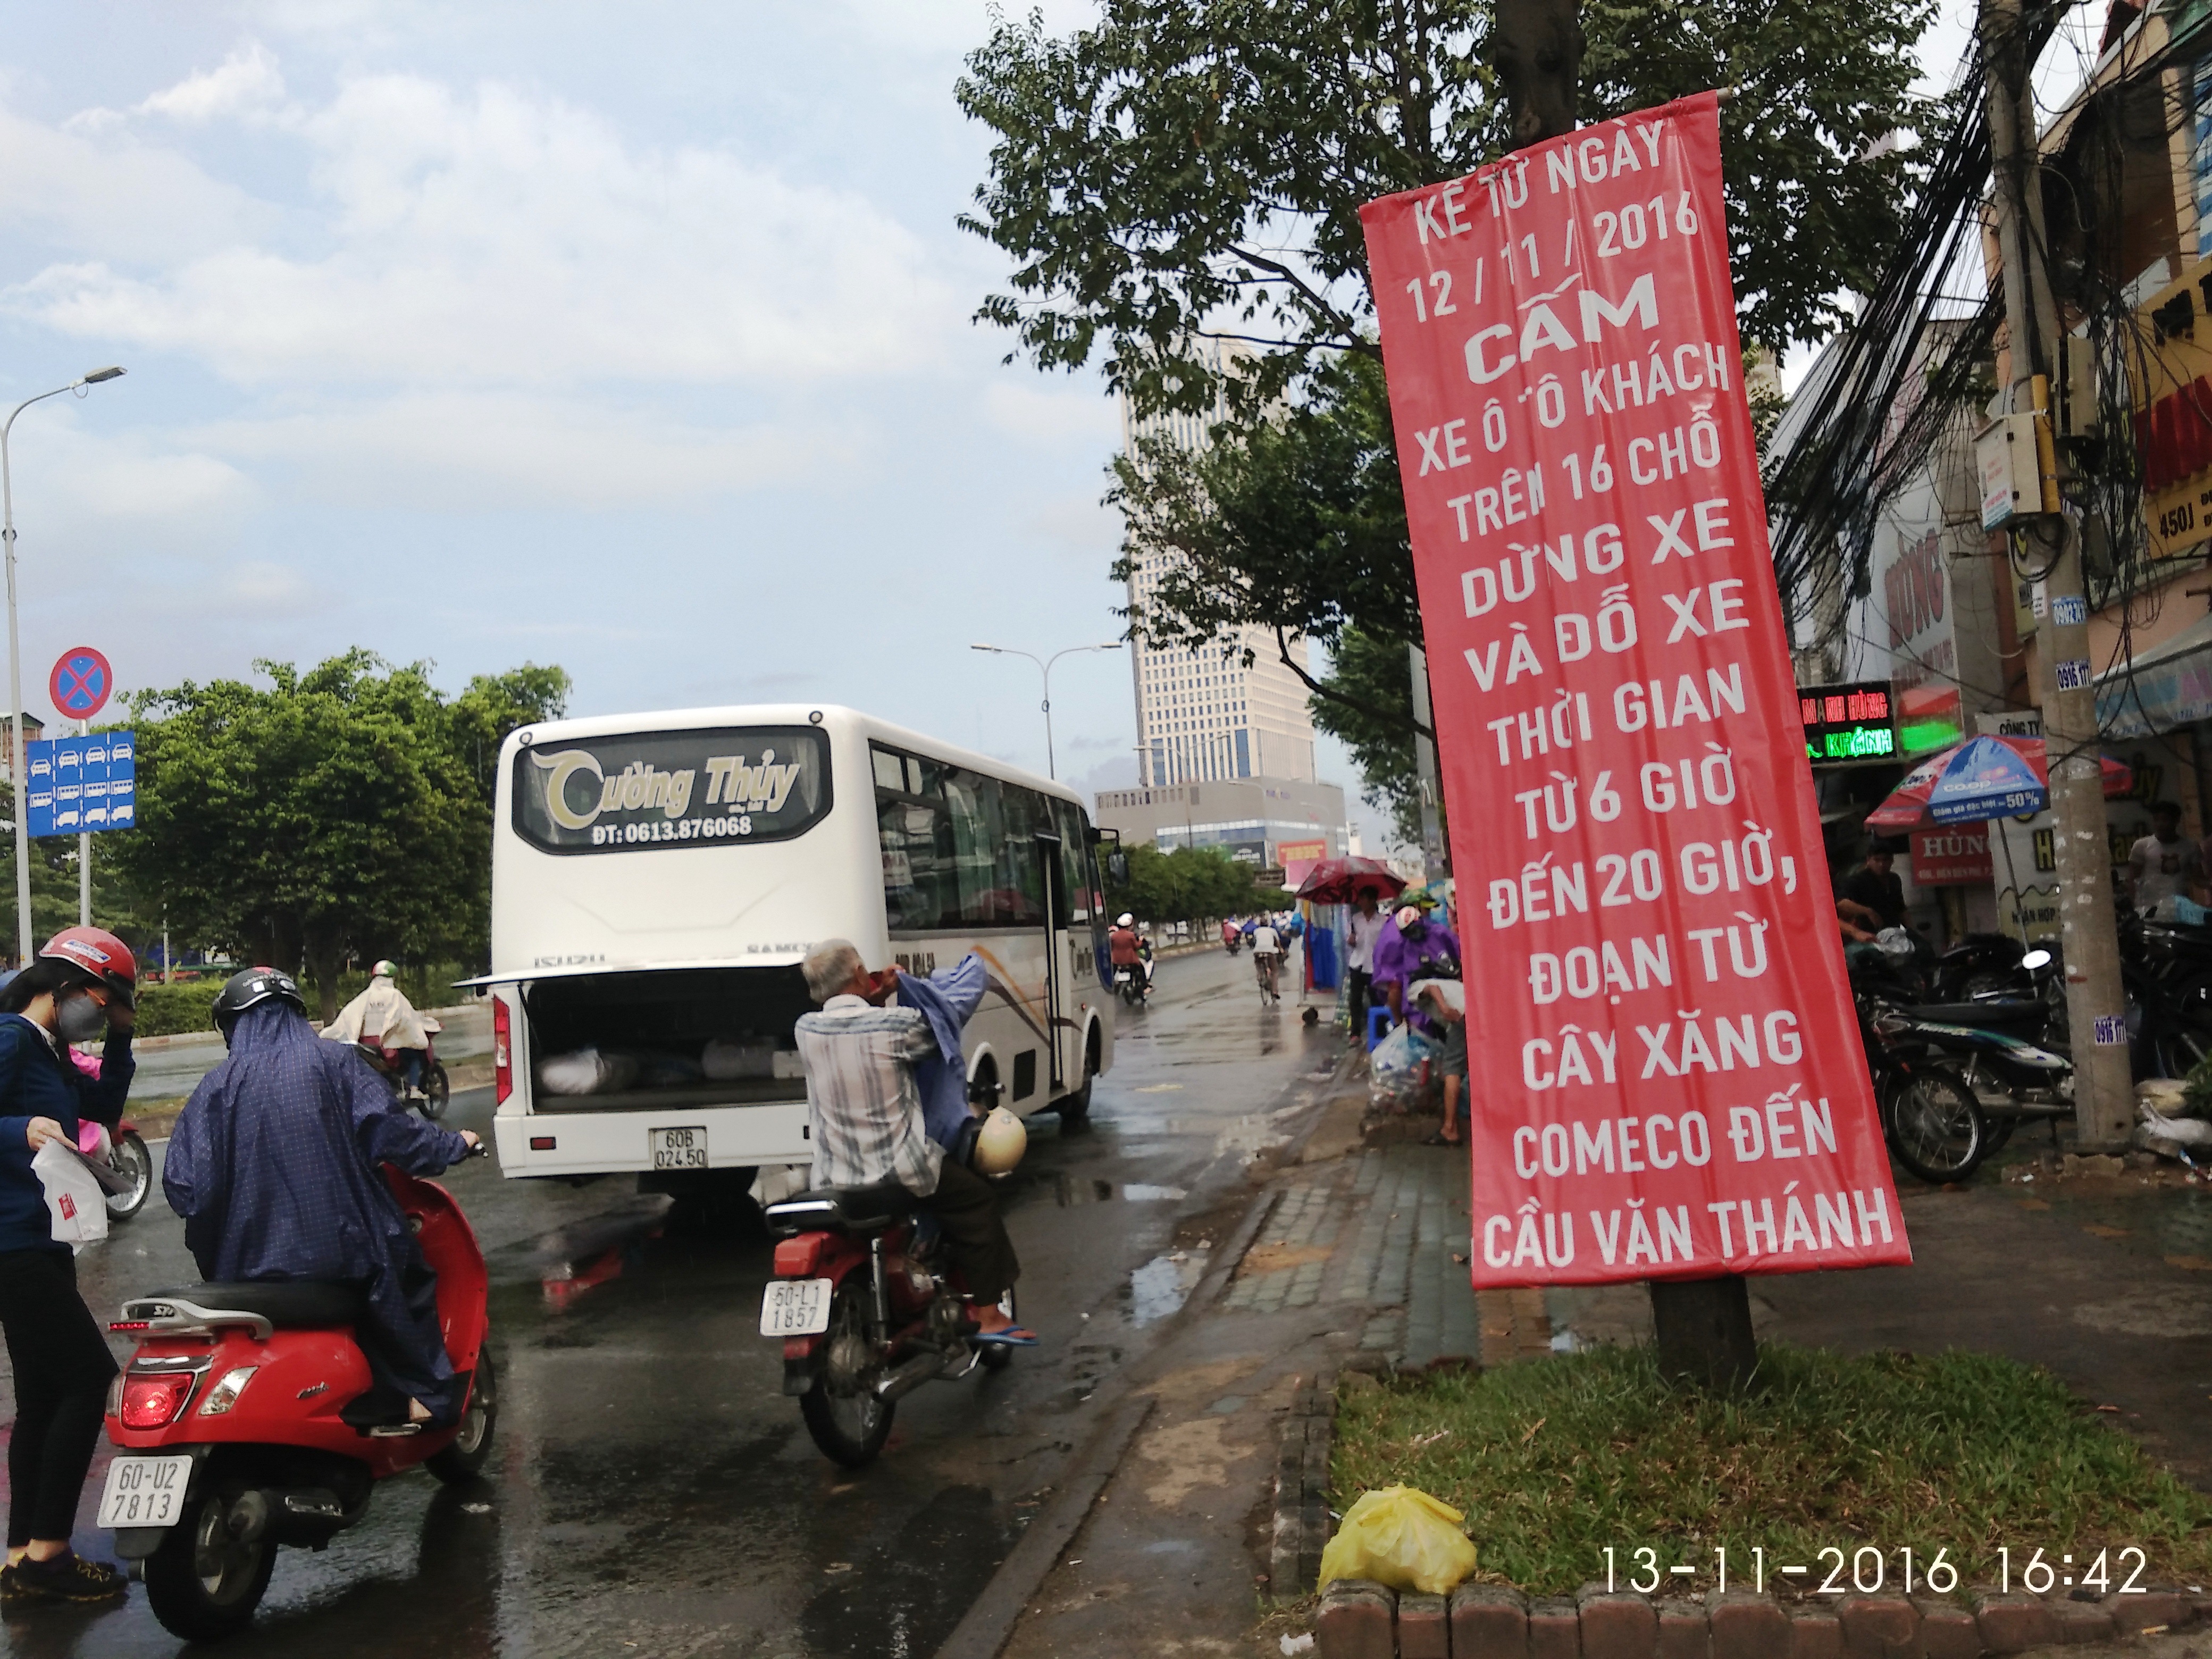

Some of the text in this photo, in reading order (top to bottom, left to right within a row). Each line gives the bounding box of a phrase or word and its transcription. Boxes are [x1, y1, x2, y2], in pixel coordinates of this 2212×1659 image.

[1545, 118, 1665, 197] NGÀY
[1405, 268, 1457, 323] 12
[1499, 233, 1540, 286] 11
[1591, 191, 1699, 258] 2016
[1463, 272, 1660, 384] CẤM
[1414, 418, 1472, 477] XE
[1482, 397, 1507, 453] Ô
[1580, 340, 1730, 417] KHÁCH
[1446, 401, 1722, 543] TRÊN 16 CHỖ
[1460, 498, 1735, 619] DỪNG XE
[1463, 578, 1749, 692] VÀ ĐỖ XE
[1487, 662, 1746, 766] THỜI GIAN
[531, 748, 696, 830] Cường
[1514, 741, 1736, 840] TỪ 6 GIỜ
[1486, 819, 1797, 930] ĐẾN 20 GIỜ,
[1922, 830, 1991, 857] HÙN
[1528, 910, 1769, 1004] ĐOẠN TỪ
[1522, 1008, 1803, 1091] CÂY XĂNG
[666, 1129, 693, 1147] 60B
[1513, 1083, 1837, 1180] COMECO ĐẾN
[1483, 1180, 1893, 1269] CẦU VĂN THÁNH
[112, 1493, 171, 1521] 7813
[119, 1463, 178, 1489] 60-U2
